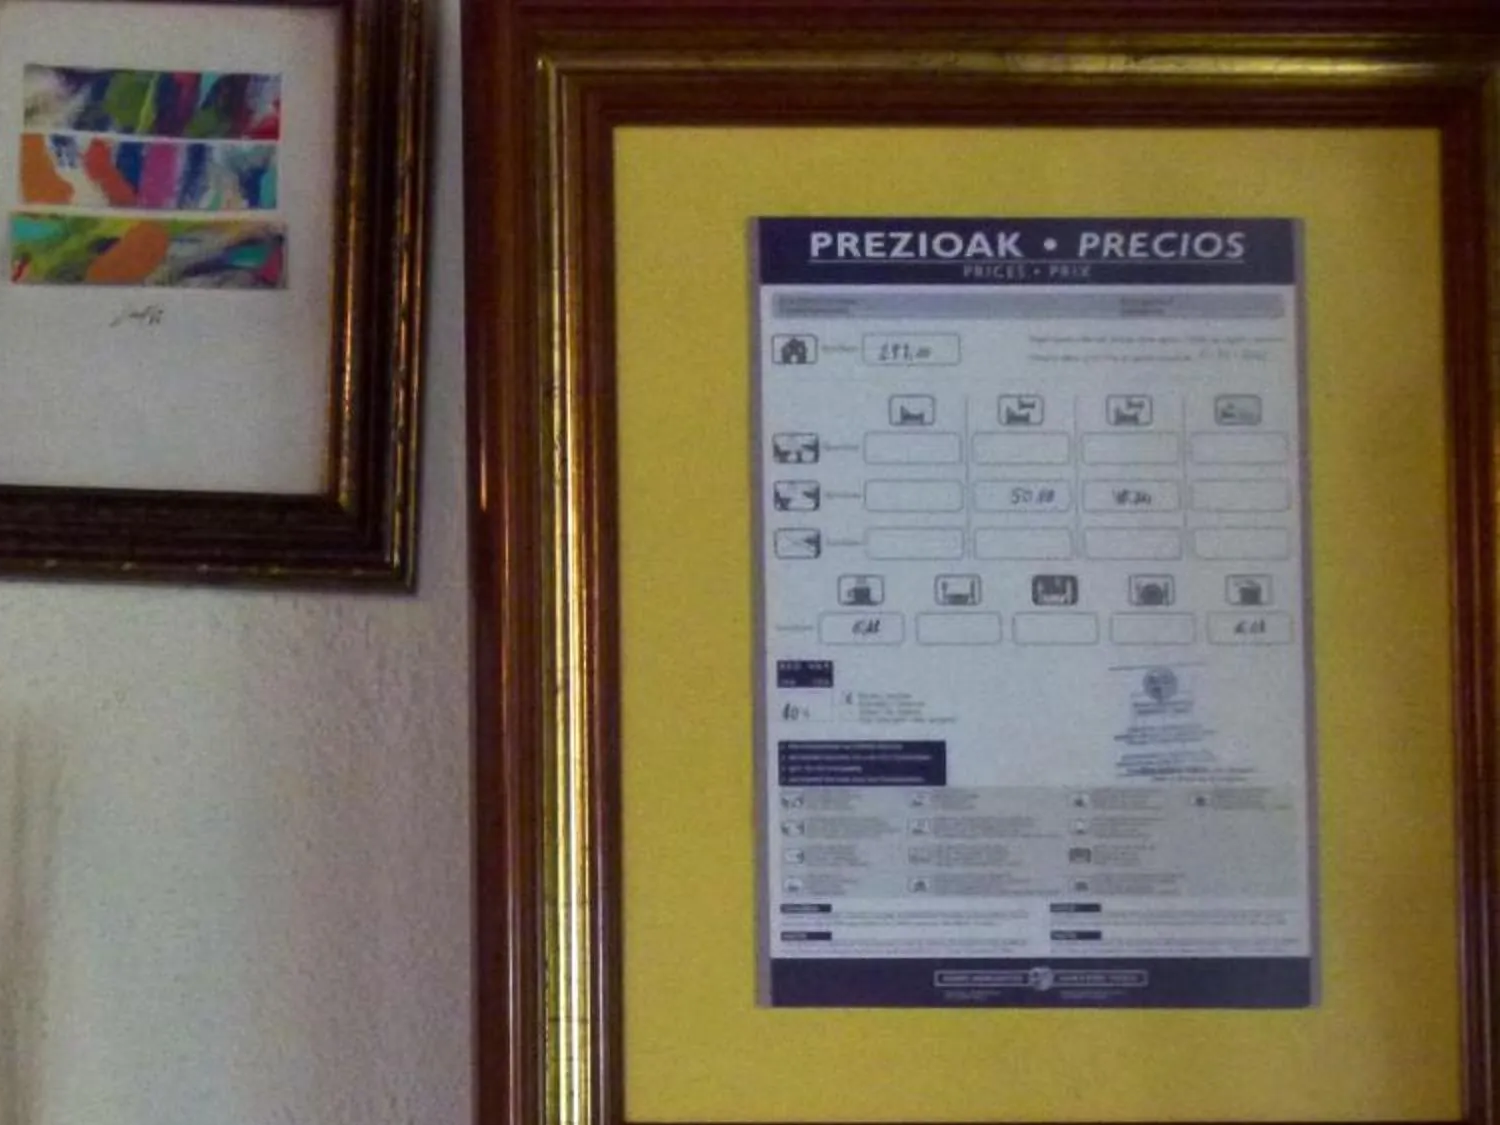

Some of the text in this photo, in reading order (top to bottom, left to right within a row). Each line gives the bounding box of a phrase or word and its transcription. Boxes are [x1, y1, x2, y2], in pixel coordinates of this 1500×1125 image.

[809, 231, 1246, 259] PREZIOAK PRECIOS
[963, 264, 1092, 279] PRICES PRIX
